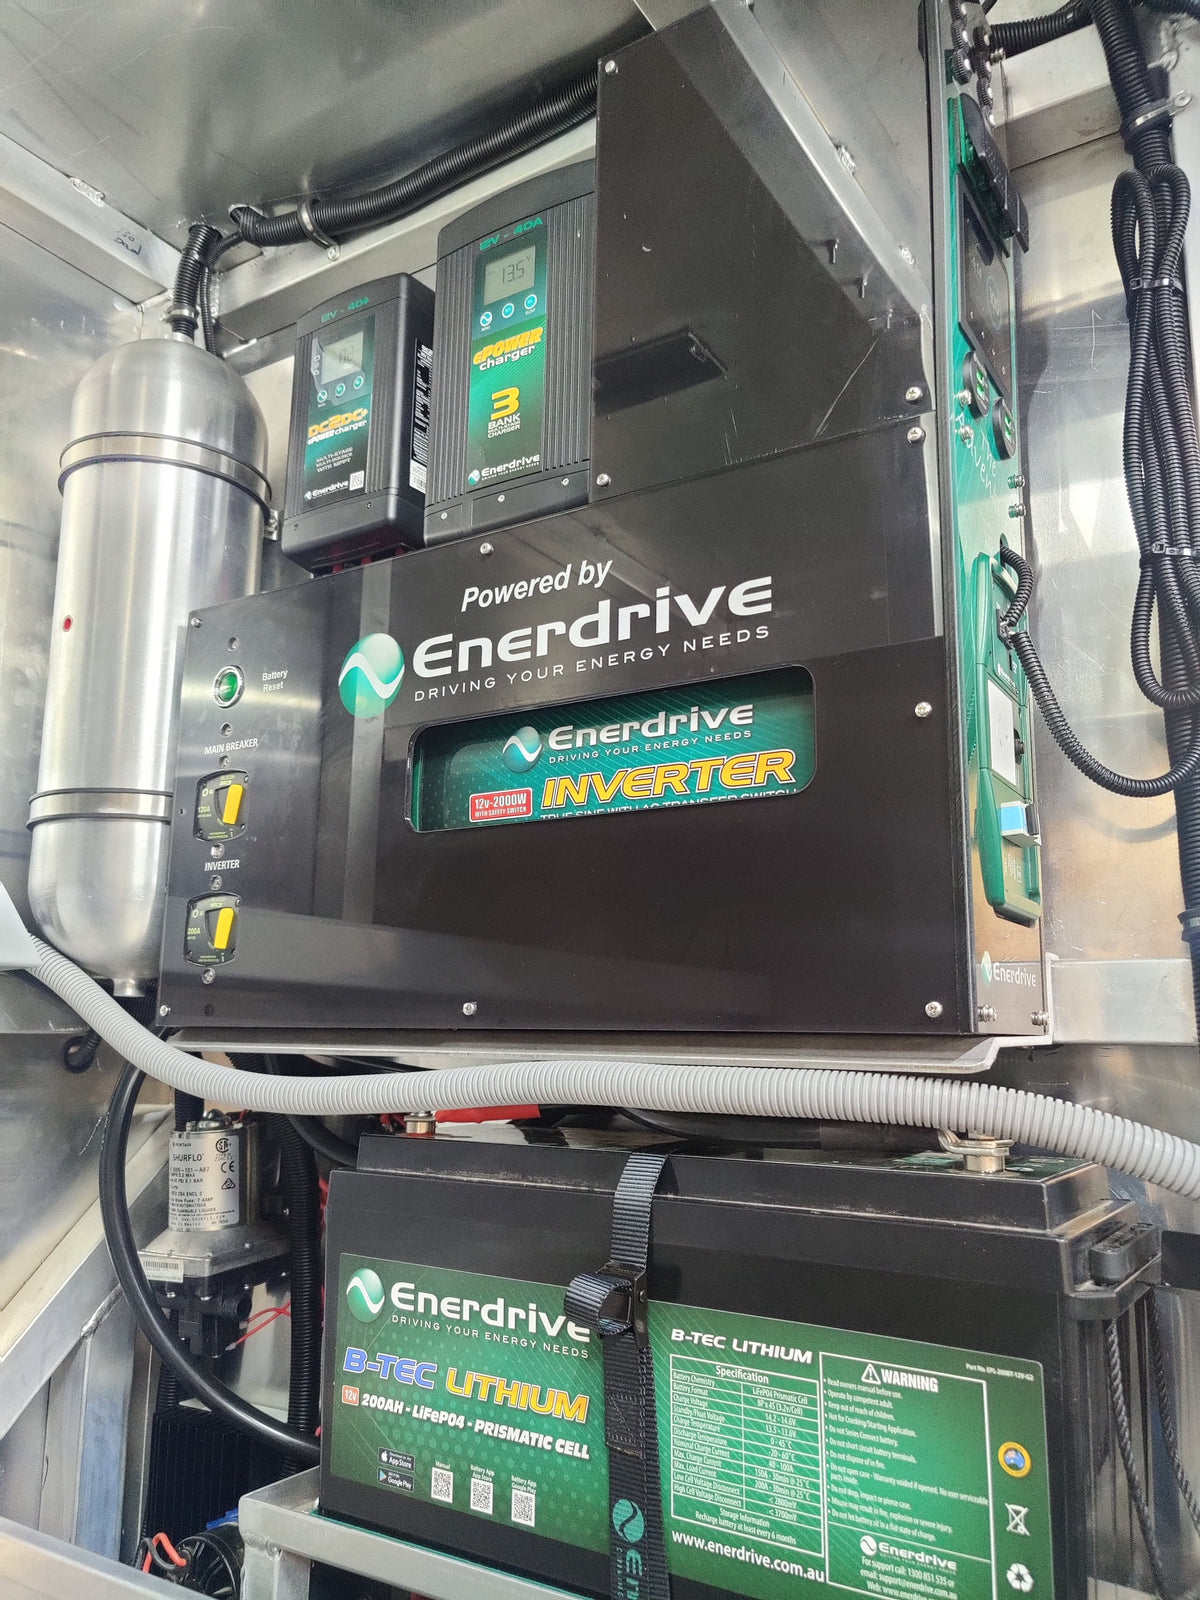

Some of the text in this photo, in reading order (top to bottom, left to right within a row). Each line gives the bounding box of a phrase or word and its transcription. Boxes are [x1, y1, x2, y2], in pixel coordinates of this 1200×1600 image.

[473, 327, 543, 365] ePOWER
[479, 345, 535, 371] charger
[491, 387, 520, 421] 3
[488, 413, 521, 429] BANK
[488, 424, 521, 438] CHARGER
[481, 454, 540, 477] Enerdrive
[312, 480, 348, 496] Enerdrive
[461, 560, 612, 612] Powered by
[412, 576, 772, 678] Enerdrive
[262, 669, 288, 682] Battery
[414, 625, 769, 702] DRIVING YOUR ENERGY NEEDS
[263, 681, 284, 693] Reset
[548, 704, 754, 750] Enerdrive
[204, 738, 258, 755] MAIN BREAKER
[549, 730, 752, 764] DRIVING YOUR ENERGY NEEDS
[541, 748, 797, 810] INVERTER
[489, 808, 506, 816] SAFETY
[507, 806, 527, 814] SWITCH
[204, 859, 240, 871] INVERTER
[993, 962, 1036, 987] Enerdrive
[173, 1153, 202, 1161] SHURFLO
[391, 1281, 590, 1343] Enerdrive
[392, 1315, 589, 1359] DRIVING YOUR ENERGY NEEDS
[671, 1328, 813, 1364] B-TEC LITHIUM
[343, 1347, 589, 1424] B-TEC LITHIUM
[673, 1371, 689, 1382] Battery
[716, 1365, 769, 1384] Specification
[881, 1368, 939, 1393] WARNING
[673, 1382, 708, 1395] Battery Format
[690, 1396, 708, 1409] Voltage
[361, 1393, 404, 1415] 200AH
[474, 1419, 553, 1451] PRISMATIC
[555, 1438, 590, 1460] CELL
[389, 1456, 411, 1469] App Store
[388, 1476, 411, 1489] Google Play
[695, 1510, 796, 1545] Recharge battery at least every 6 months
[719, 1507, 769, 1527] Storage Information
[672, 1530, 825, 1583] www.enerdrive.com.au
[879, 1542, 957, 1571] Enerdrive
[862, 1556, 871, 1566] For
[872, 1560, 894, 1573] support
[908, 1568, 922, 1580] 1300
[923, 1571, 934, 1582] 851
[936, 1575, 947, 1586] 535
